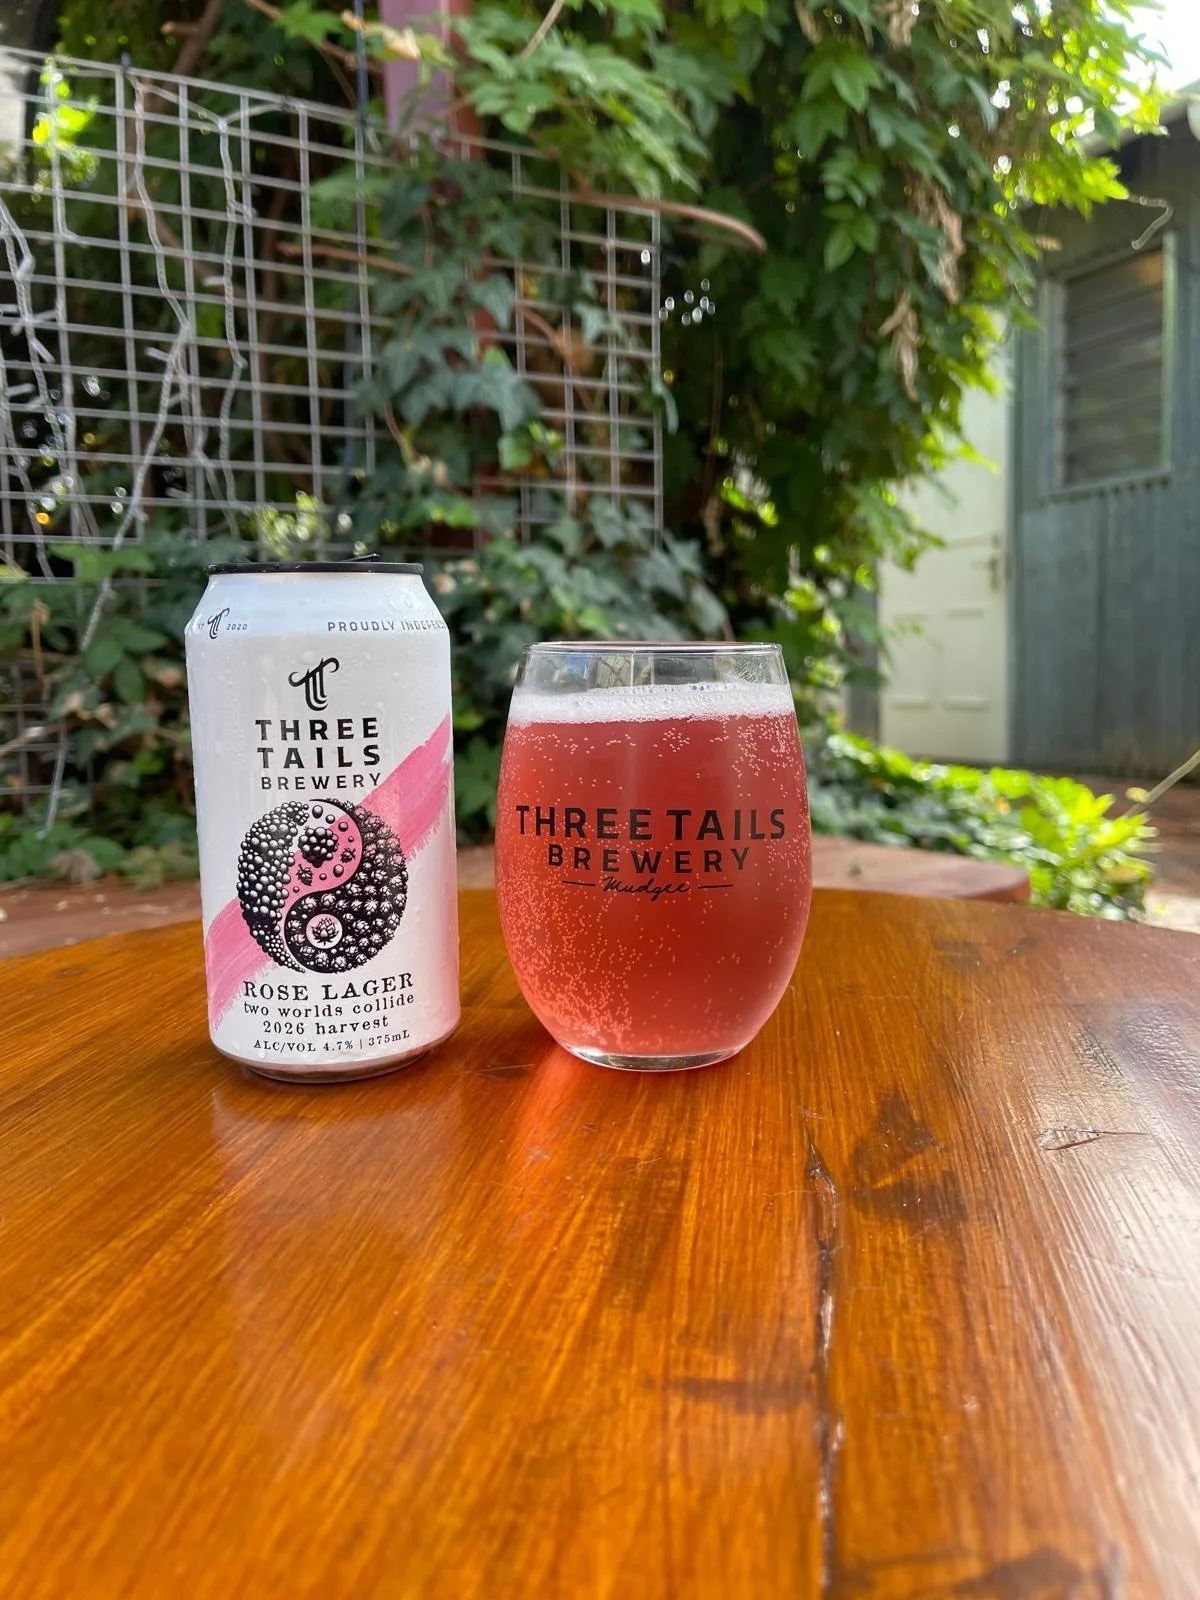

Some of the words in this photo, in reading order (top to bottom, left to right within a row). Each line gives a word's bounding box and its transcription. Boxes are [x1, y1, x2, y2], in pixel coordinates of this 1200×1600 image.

[226, 623, 248, 631] 2020
[327, 621, 394, 632] PROUDLY
[255, 717, 379, 741] THREE
[257, 744, 380, 769] TAILS
[261, 773, 381, 790] BREWERY
[515, 805, 653, 840] THREE
[666, 808, 785, 841] TAILS
[548, 843, 750, 874] BREWERY
[603, 875, 690, 902] Mudgee
[243, 980, 309, 1001] ROSE
[321, 972, 413, 1000] LAGER
[244, 1001, 269, 1016] two
[278, 1004, 343, 1018] worlds
[352, 993, 414, 1014] collide
[263, 1020, 305, 1035] 2026
[315, 1015, 389, 1035] harvest
[253, 1039, 316, 1053] ALC/VOL
[323, 1040, 353, 1052] 4.7%
[368, 1029, 410, 1047] 375mL
